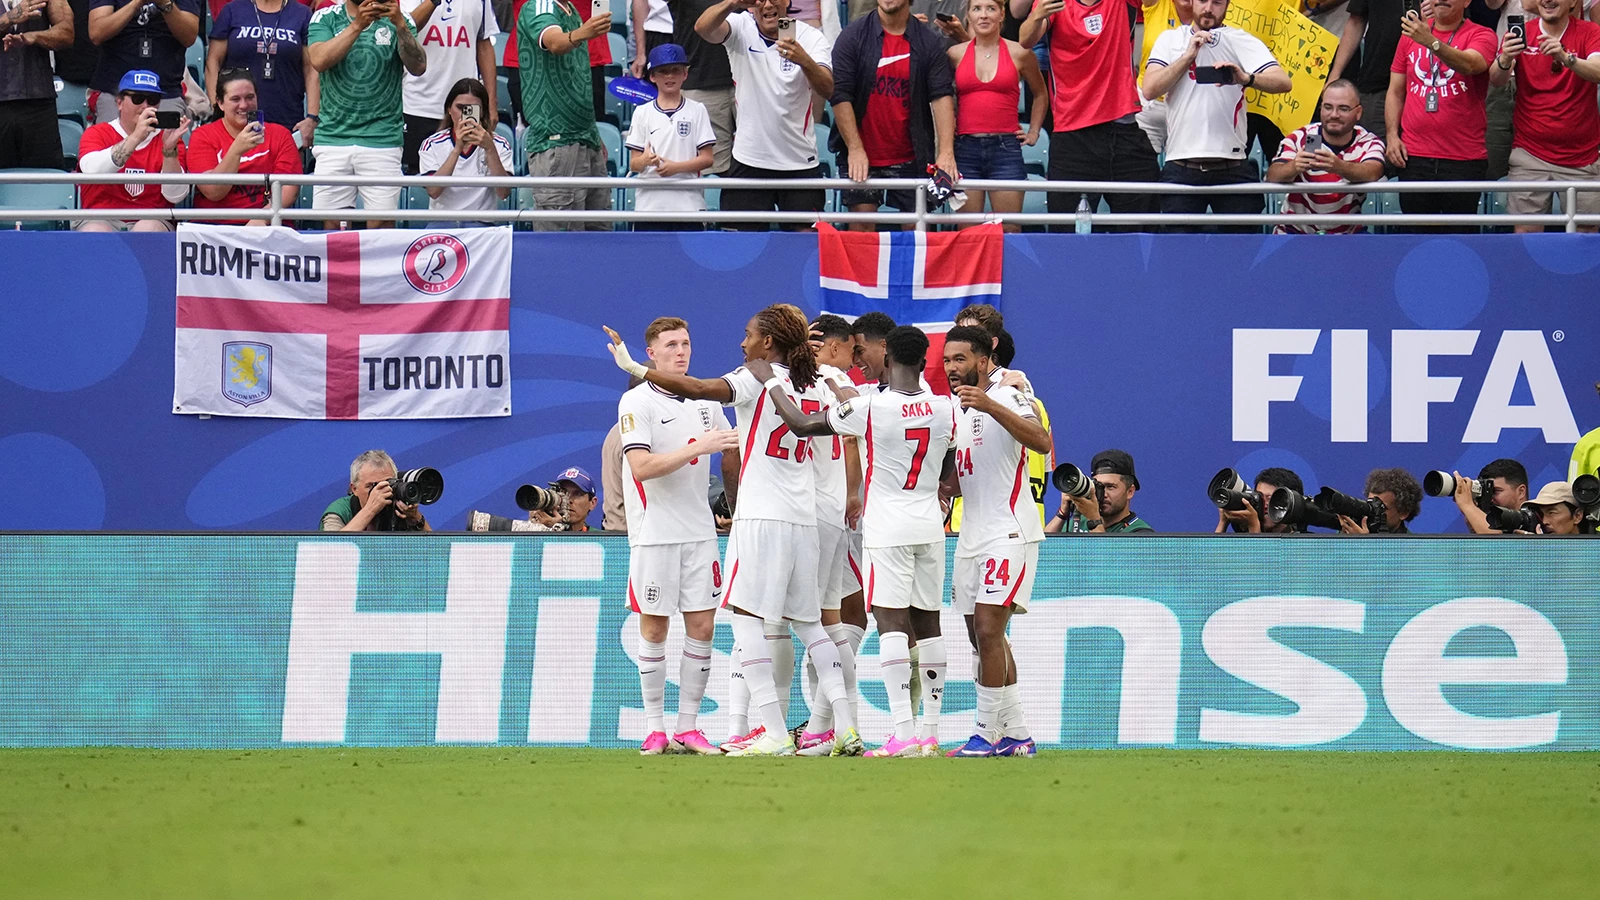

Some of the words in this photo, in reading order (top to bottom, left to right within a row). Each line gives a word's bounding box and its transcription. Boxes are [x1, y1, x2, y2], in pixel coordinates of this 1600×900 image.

[236, 26, 298, 45] NORGE
[422, 24, 470, 48] AIA
[414, 236, 457, 251] BRISTOL
[180, 241, 322, 283] ROMFORD
[423, 281, 449, 292] CITY
[363, 354, 503, 391] TORONTO
[228, 390, 248, 400] ASTON
[248, 390, 266, 400] VILLA
[902, 402, 933, 418] SAKA
[902, 427, 931, 490] 7
[957, 447, 974, 477] 24
[712, 560, 722, 588] 8
[984, 558, 1010, 586] 24
